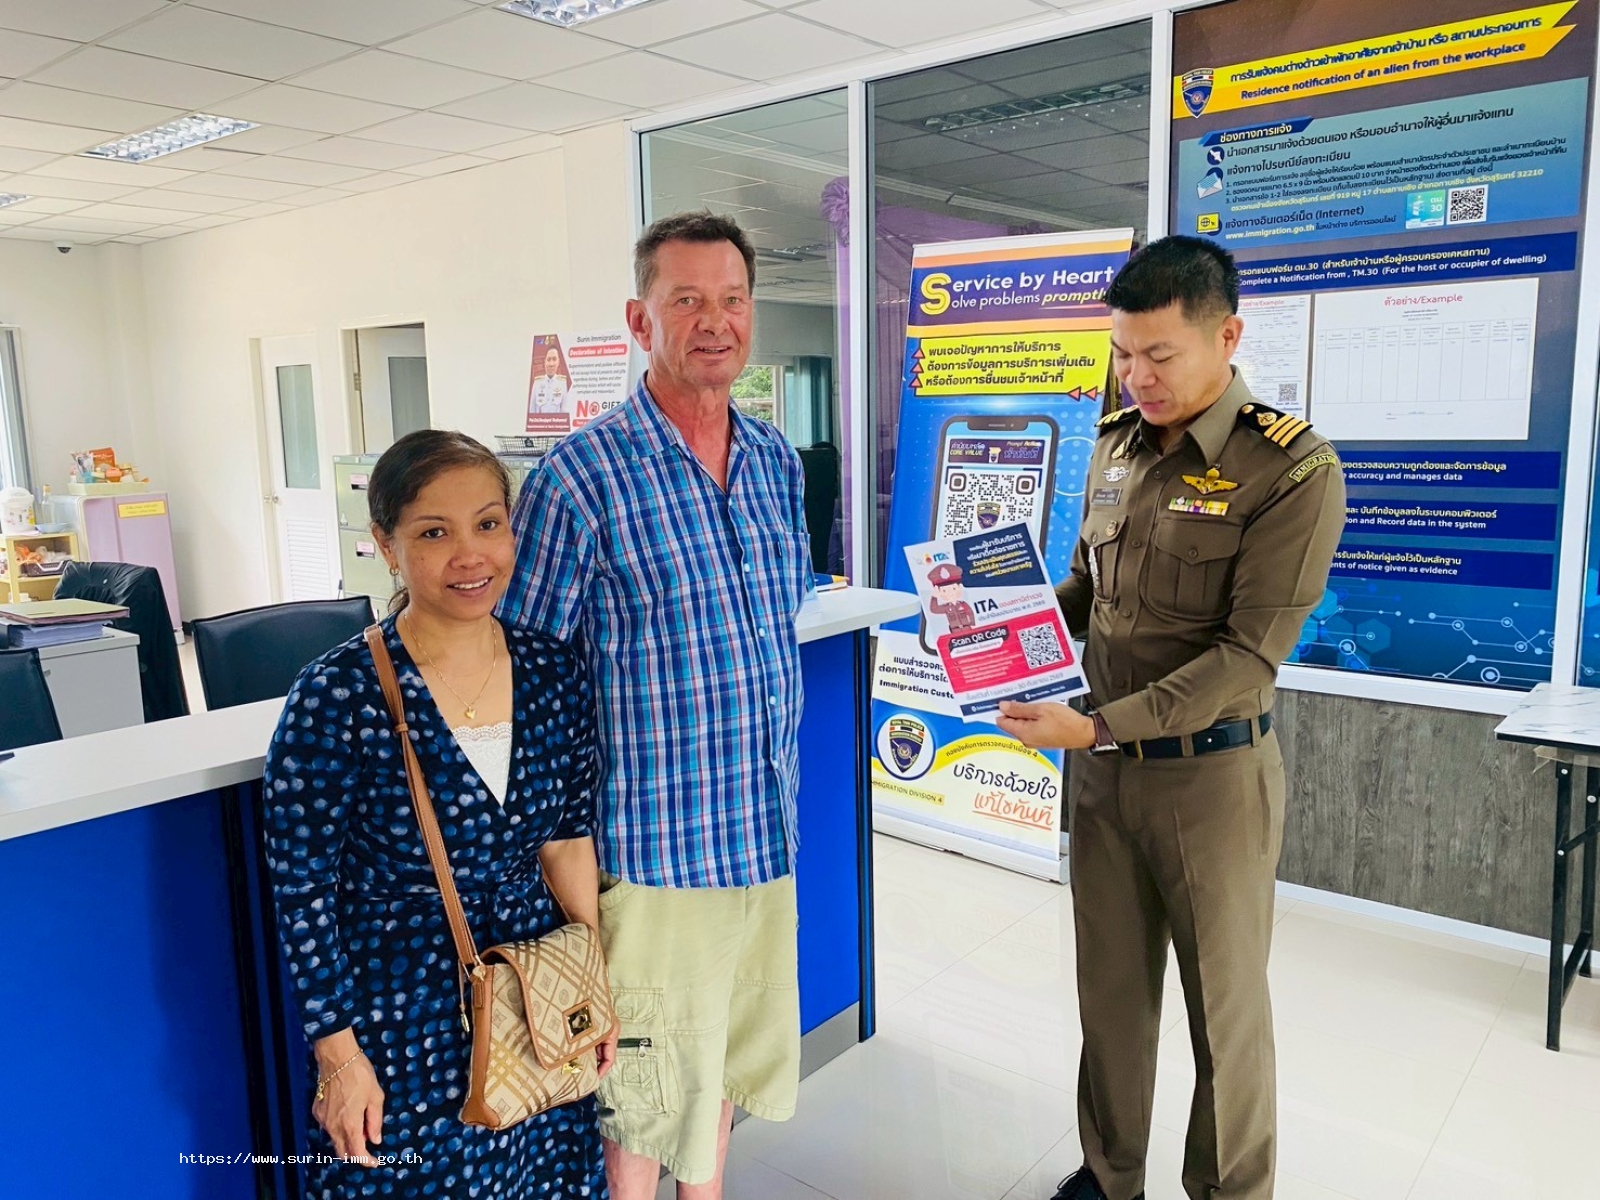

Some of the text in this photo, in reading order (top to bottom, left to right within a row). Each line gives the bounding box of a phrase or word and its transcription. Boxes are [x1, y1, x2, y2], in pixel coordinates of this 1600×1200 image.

[1428, 33, 1449, 46] หรือ
[1450, 17, 1541, 42] สถานประกอบการ
[1241, 42, 1526, 99] Residence notification of an alien from the workplace
[1220, 123, 1292, 143] ช่องทางการแจ้ง
[1227, 106, 1514, 158] นำเอกสารมาแจ้งด้วยตนเอง หรือมอบอำนาจให้ผู้อื่นมาแจ้งแทน
[1227, 151, 1351, 175] แจ้งทางไปรษณีย์ลงทะเบียน
[1225, 205, 1365, 229] แจ้งทางอินเตอร์เน็ต (Internet)
[1225, 223, 1315, 240] www.immigration.go.th
[1279, 271, 1325, 284] Notification
[1327, 271, 1346, 280] from
[1352, 267, 1379, 277] TM.30
[1382, 267, 1400, 276] (For
[1401, 264, 1416, 273] the
[1417, 263, 1437, 272] host
[1450, 259, 1490, 271] occupier
[1491, 258, 1502, 266] of
[1502, 253, 1547, 265] dwelling)
[1020, 271, 1046, 291] by
[1052, 265, 1115, 286] Heart
[979, 291, 1040, 310] problems
[1384, 293, 1463, 307] ตัวอย่าง/Example
[591, 334, 621, 343] Immigration
[928, 341, 1062, 356] พบเจอปัญหาการให้บริการ
[927, 354, 1096, 372] ต้องการข้อมูลการบริการเพิ่มเติม
[925, 369, 1064, 387] หรือต้องการชื่นชมเจ้าหน้าที่
[1348, 472, 1463, 482] accuracy and manages data
[1359, 517, 1375, 525] and
[1377, 517, 1405, 526] Record
[1406, 518, 1426, 527] data
[1428, 519, 1436, 527] in
[1438, 520, 1453, 528] the
[1454, 521, 1487, 530] system
[1357, 563, 1383, 571] notice
[1384, 564, 1407, 573] given
[1419, 567, 1458, 576] evidence
[973, 598, 999, 614] ITA
[951, 628, 1008, 645] Scan QR Code
[879, 679, 929, 695] Immigration
[953, 763, 1057, 800] บริการด้วยใจ
[909, 789, 937, 802] DIVISION
[974, 790, 1054, 826] แก้ไขทันที
